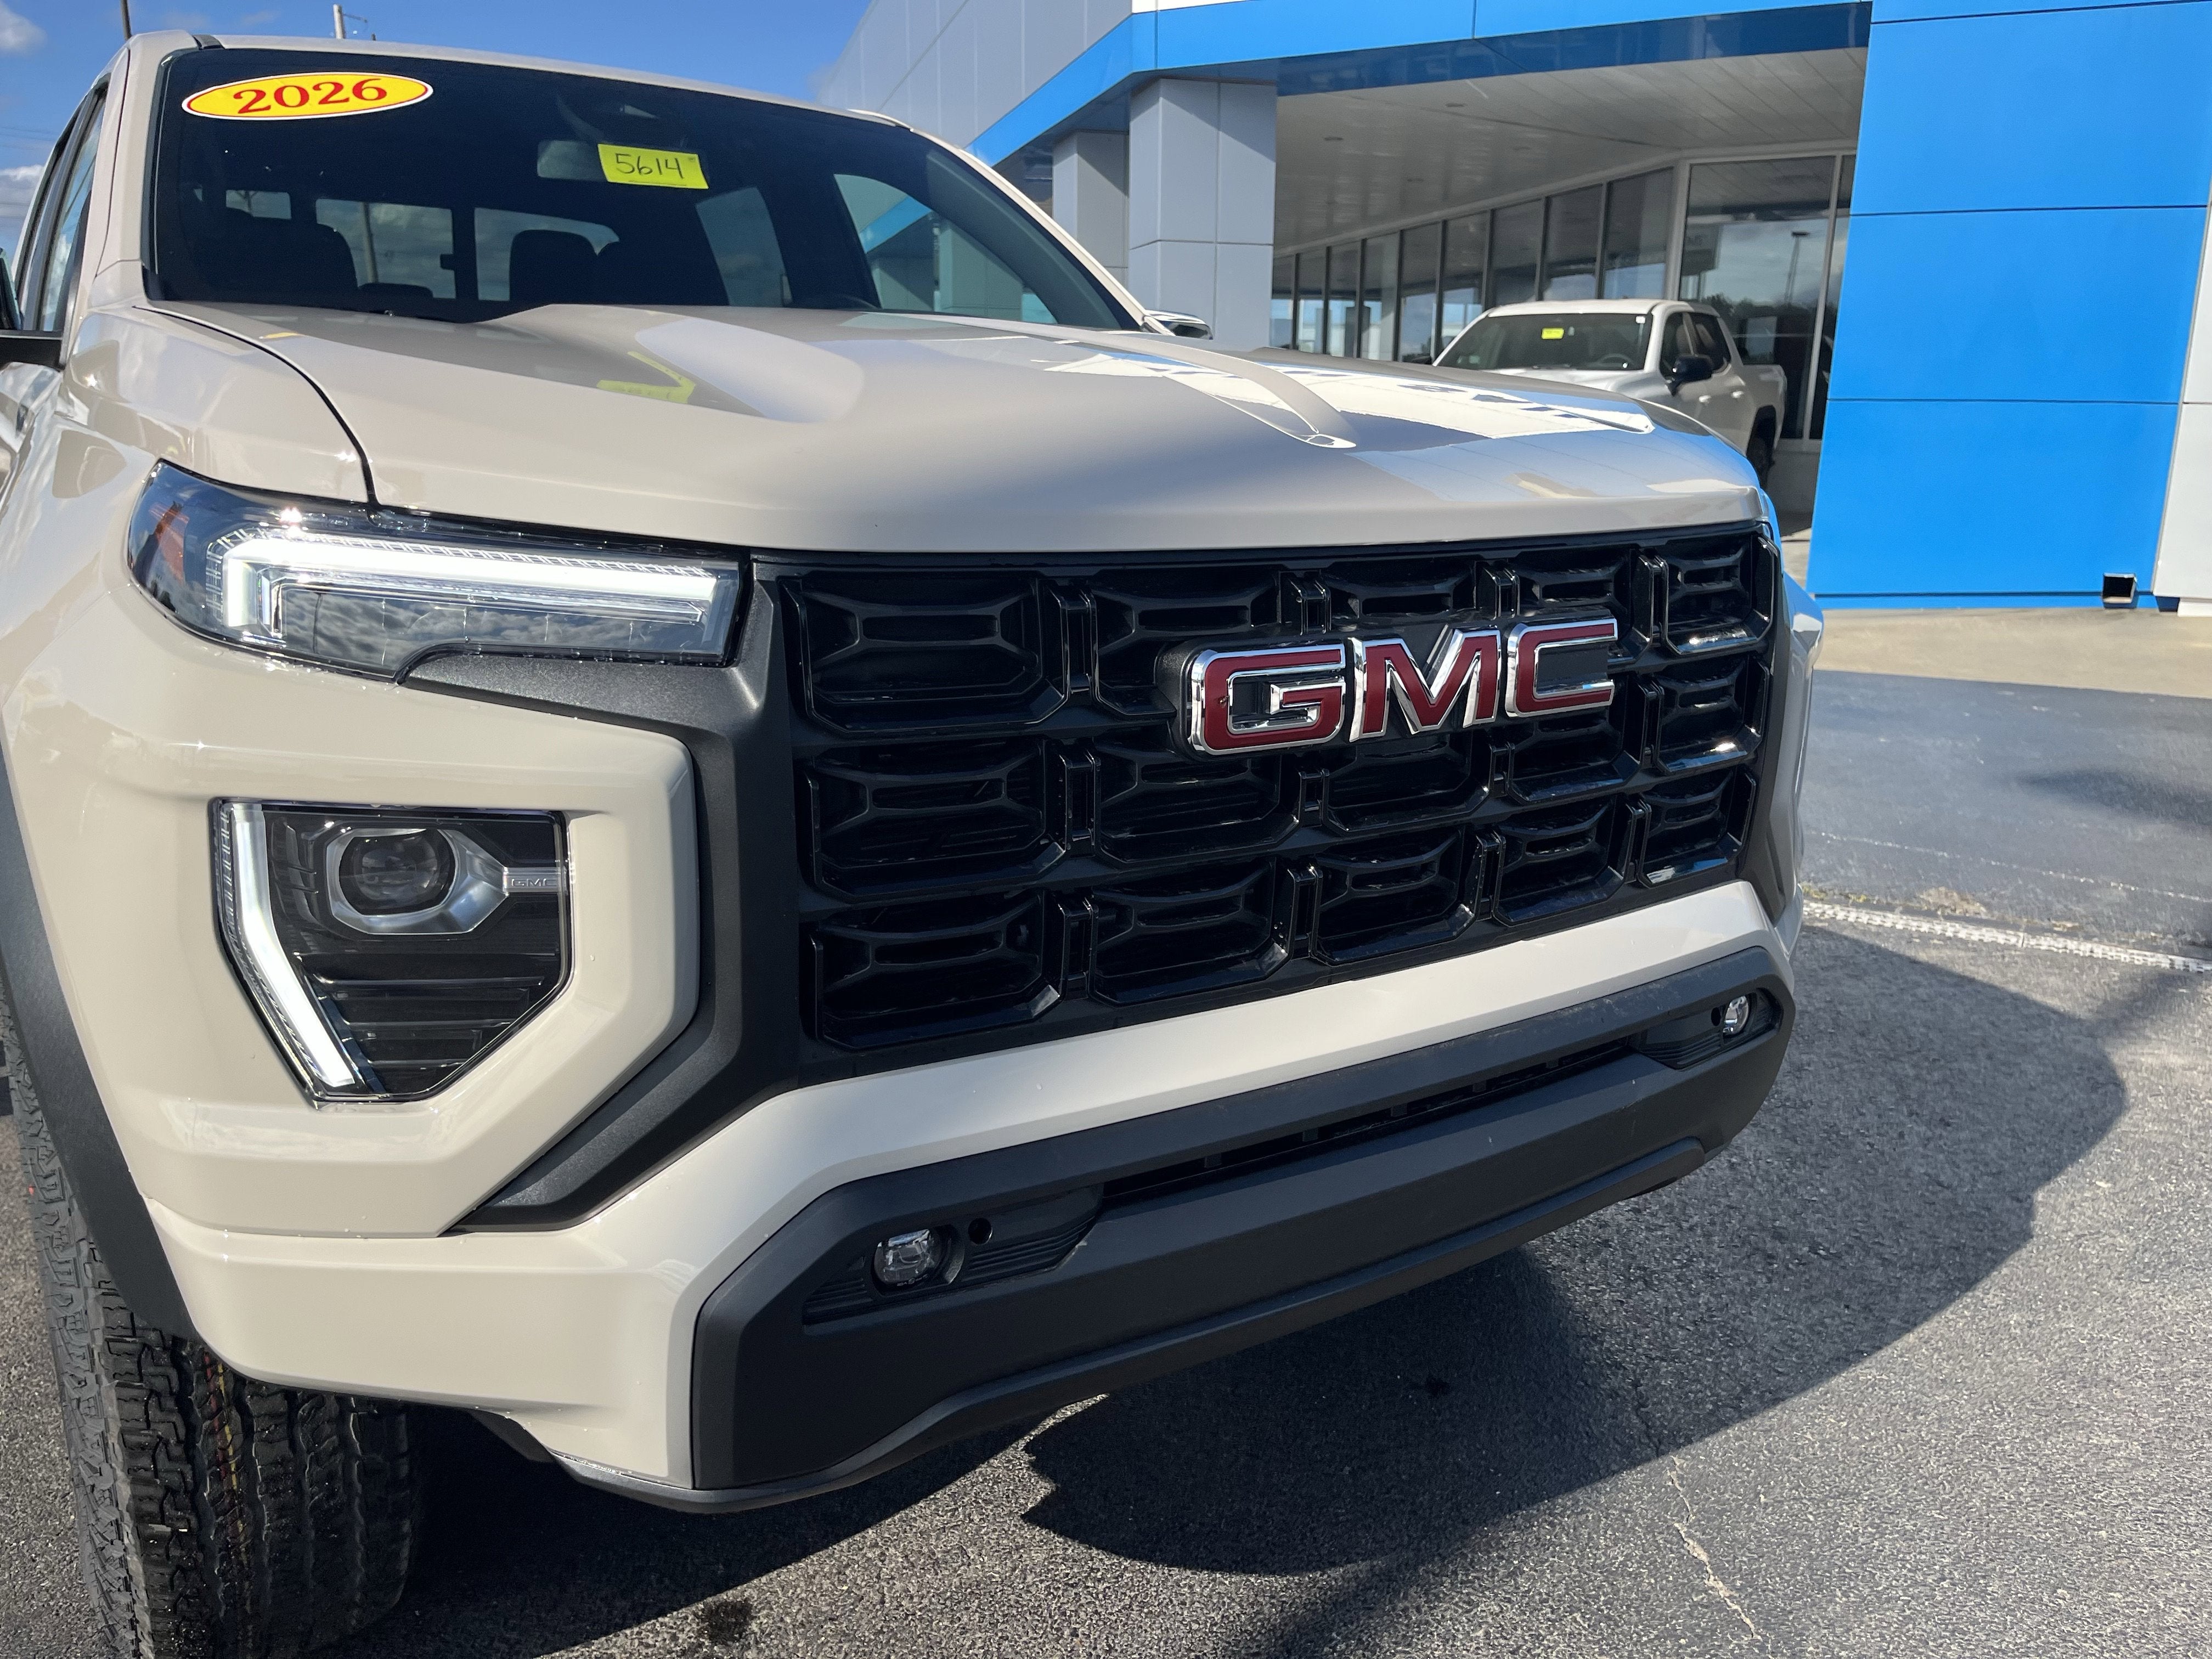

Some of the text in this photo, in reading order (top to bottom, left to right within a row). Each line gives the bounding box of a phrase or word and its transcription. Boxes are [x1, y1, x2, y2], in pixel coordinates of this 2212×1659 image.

[233, 79, 387, 114] 2026
[615, 153, 684, 179] 5614
[1189, 618, 1618, 755] GMC
